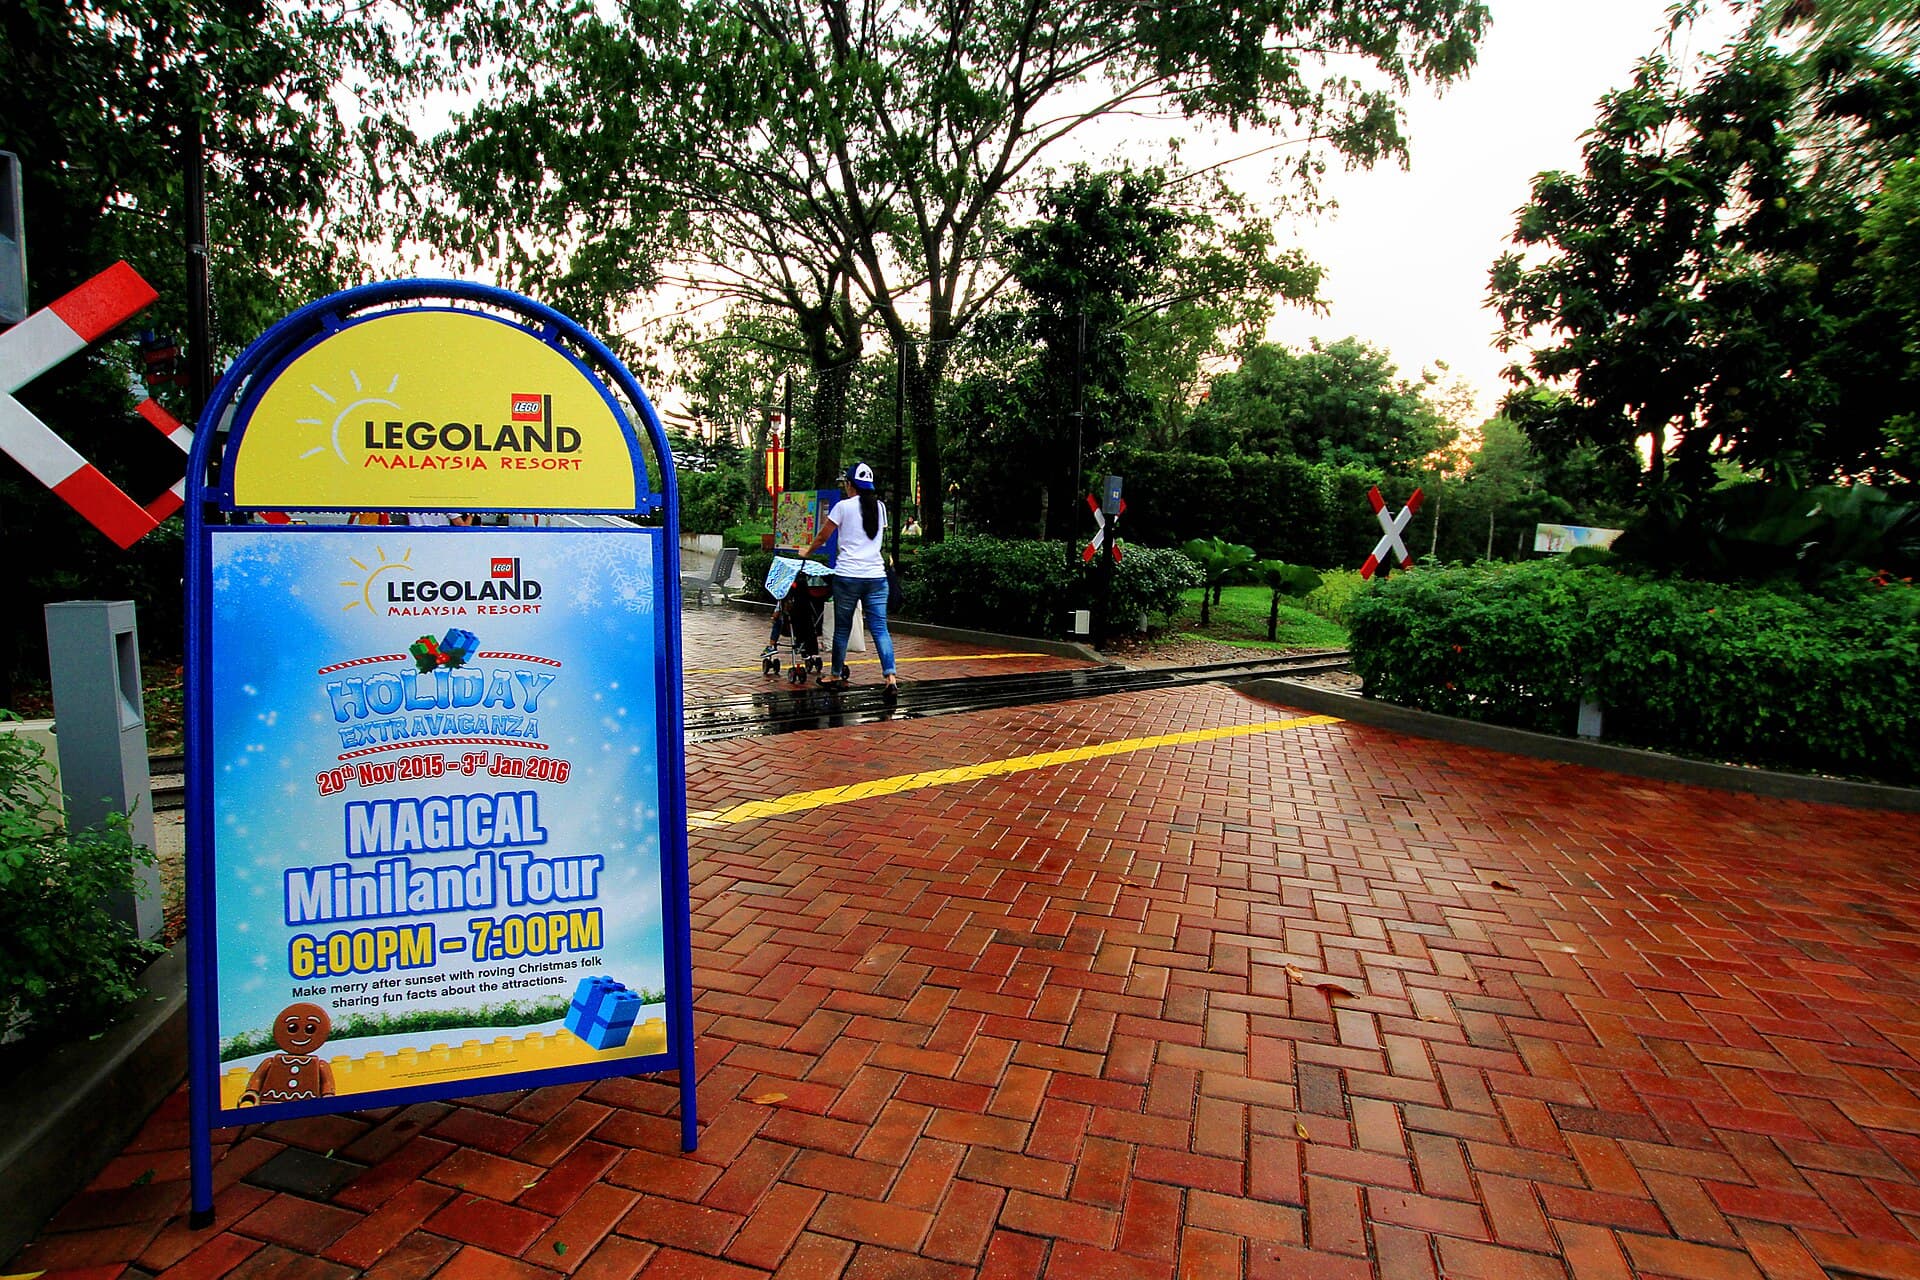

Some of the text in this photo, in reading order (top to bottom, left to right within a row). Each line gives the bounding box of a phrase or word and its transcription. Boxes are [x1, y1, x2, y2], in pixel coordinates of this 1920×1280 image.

[365, 394, 582, 453] LEGOLAND
[513, 401, 541, 414] LEGO
[364, 454, 583, 471] MALAYSIA RESORT
[388, 557, 542, 602] LEGOLAND
[493, 563, 512, 573] LEGO
[388, 604, 542, 617] MALAYSIA RESORT
[326, 668, 556, 723] HOLIDAY
[338, 713, 539, 749] EXTRAVAGANZA
[317, 764, 355, 795] 20th
[358, 761, 397, 786] Nov
[399, 754, 445, 780] 2015
[462, 751, 488, 776] 3rd
[490, 753, 523, 778] Jan
[526, 756, 570, 784] 2016
[347, 792, 545, 857] MAGICAL
[284, 852, 603, 925] Miniland Tour
[289, 924, 435, 978] 6:00PM
[471, 909, 603, 960] 7:00PM
[292, 956, 602, 998] Make merry after sunset with roving Christmas folk
[332, 973, 568, 1009] sharing fun facts about the attractions.
